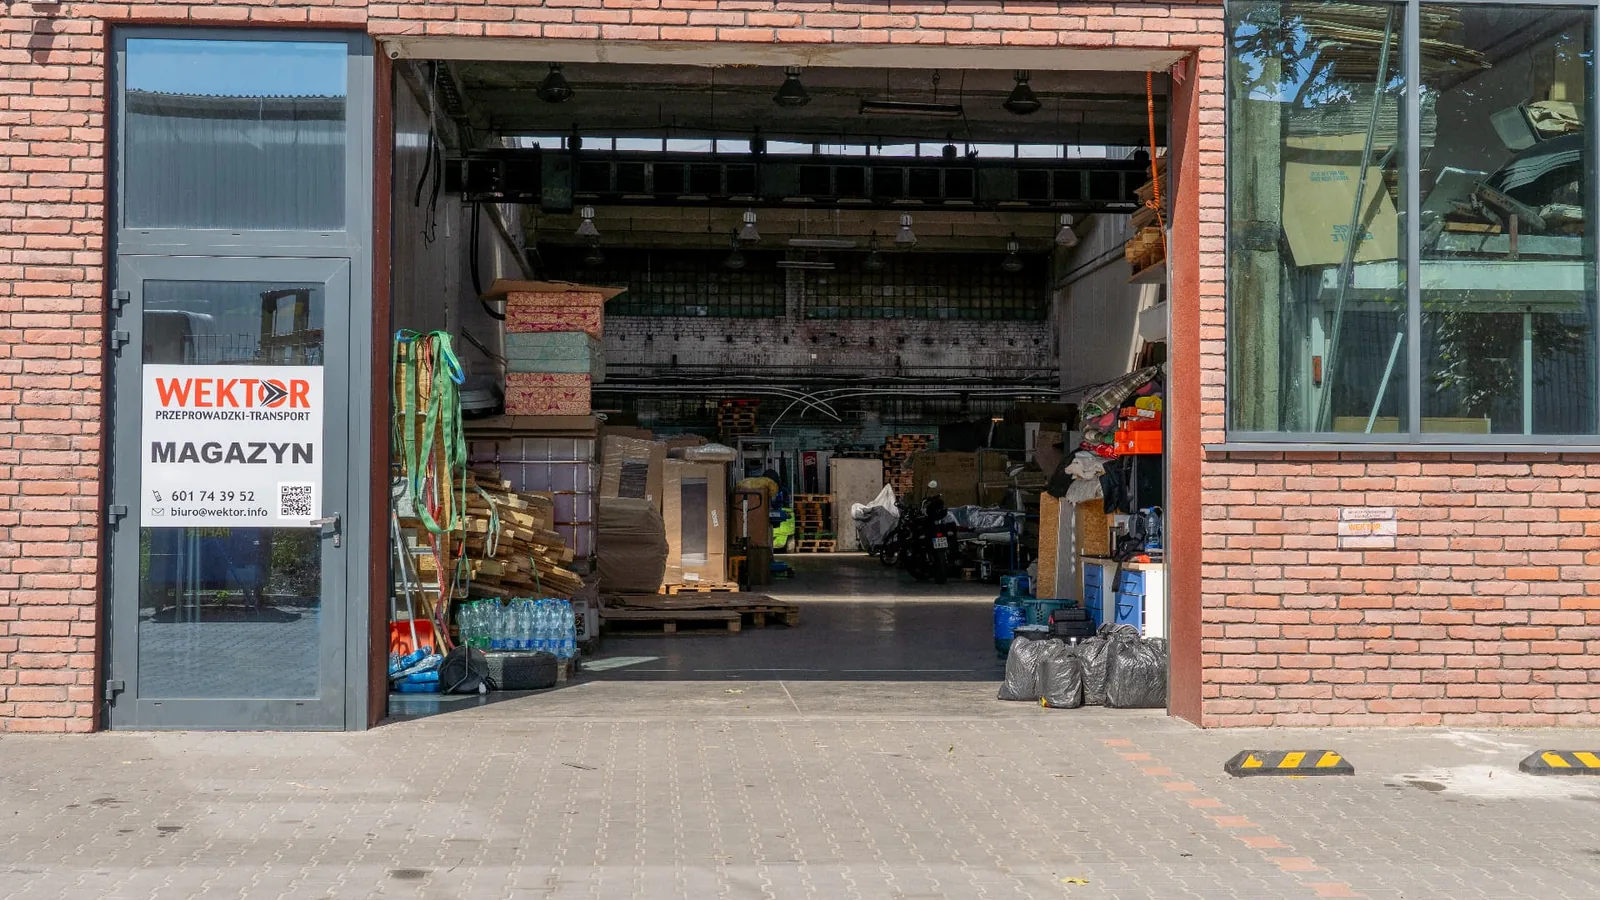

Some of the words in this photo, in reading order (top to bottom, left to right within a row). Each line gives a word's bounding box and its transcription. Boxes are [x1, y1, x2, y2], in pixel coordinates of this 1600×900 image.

[155, 377, 311, 408] WEKTOR
[155, 410, 311, 421] PRZEPROWADZKI-TRANSPORT
[151, 441, 313, 464] MAGAZYN
[171, 490, 194, 502] 601
[200, 490, 215, 502] 74
[219, 490, 235, 502] 39
[239, 490, 255, 502] 52
[170, 507, 268, 517] biuro@wektor.info
